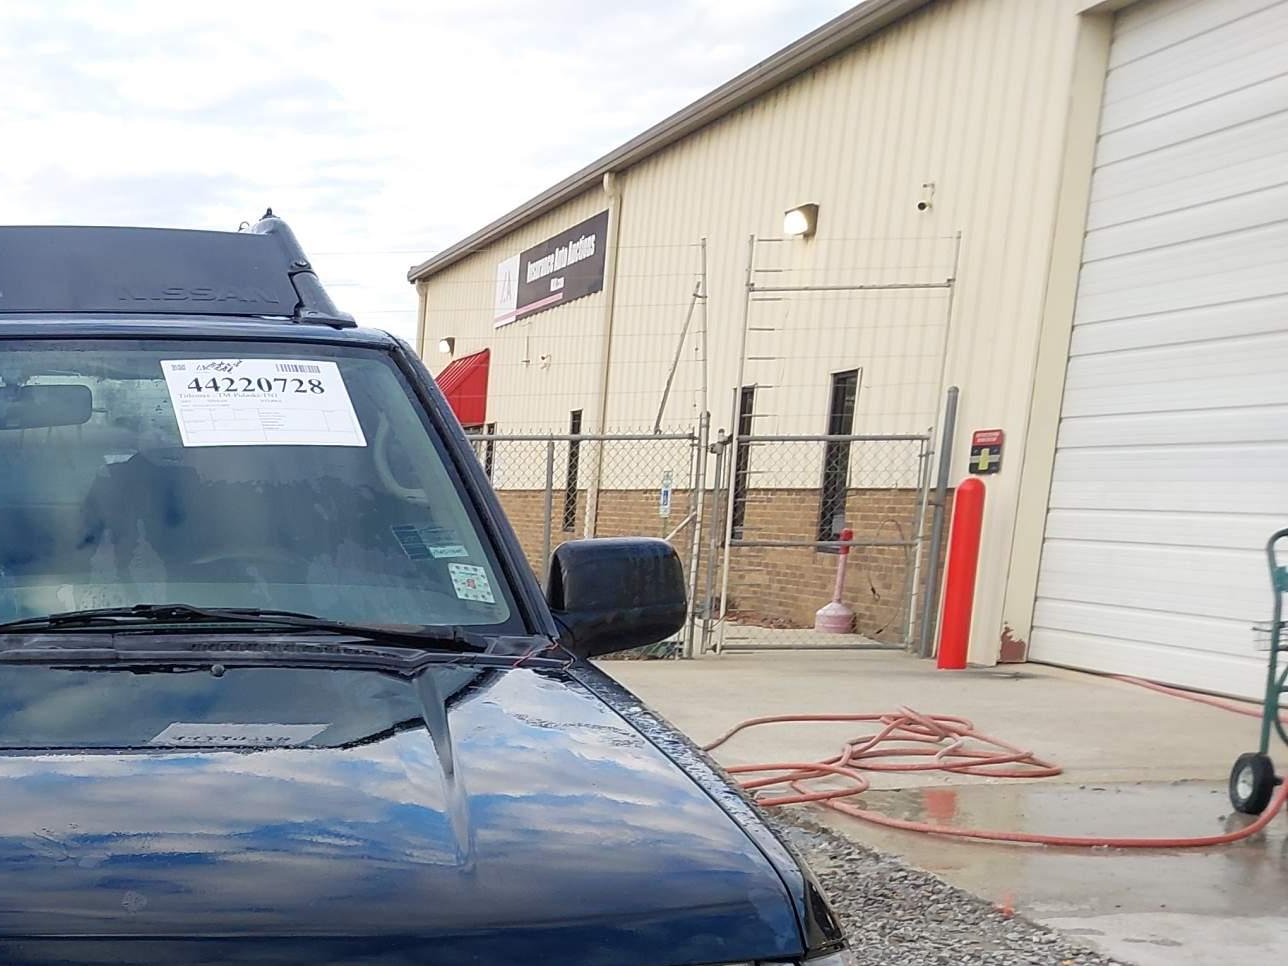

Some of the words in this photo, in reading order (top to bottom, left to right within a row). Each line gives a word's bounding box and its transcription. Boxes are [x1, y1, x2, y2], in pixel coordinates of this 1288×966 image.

[526, 253, 555, 284] Insurance
[554, 246, 569, 272] Auto
[567, 234, 596, 266] Auctions
[118, 287, 280, 304] NISSAN
[187, 377, 325, 395] 44220728
